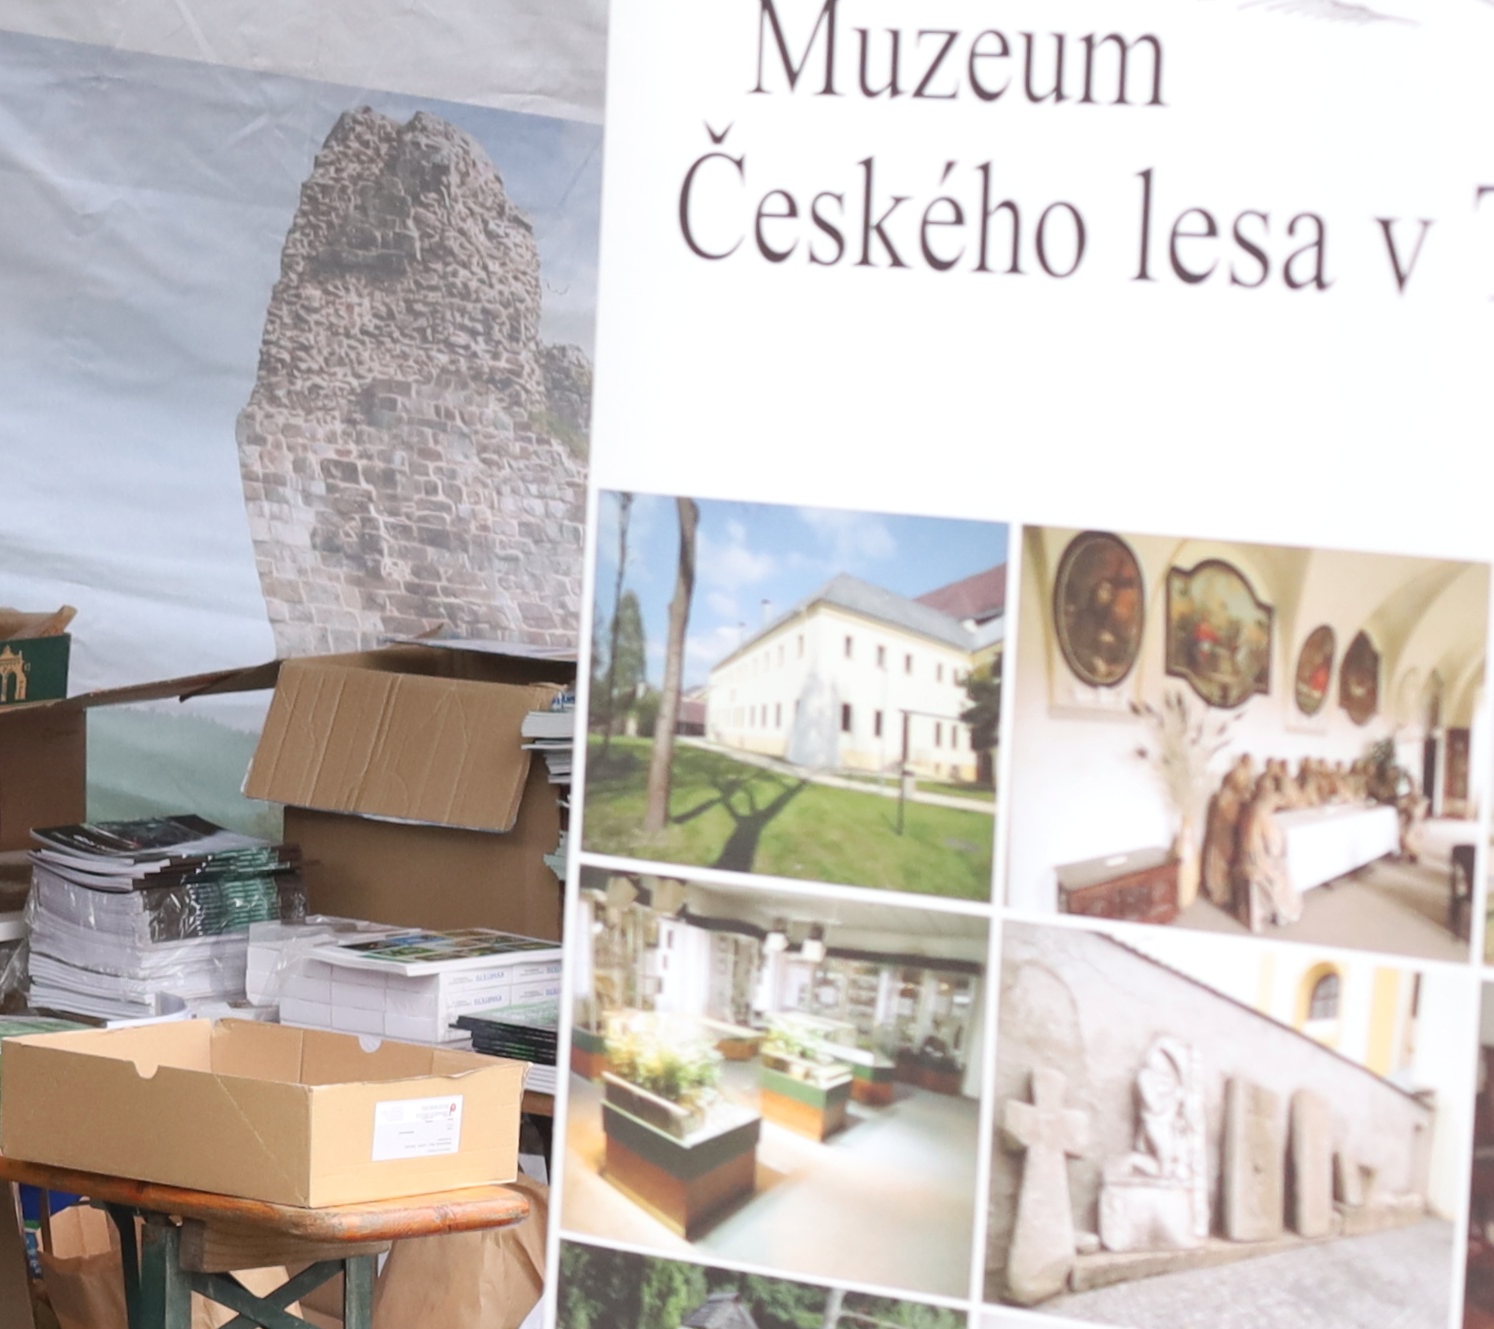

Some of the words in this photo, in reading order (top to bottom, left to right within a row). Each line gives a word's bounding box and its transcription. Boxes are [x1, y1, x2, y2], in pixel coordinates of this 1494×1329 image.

[677, 121, 1088, 279] Českého
[1130, 167, 1336, 292] lesa
[1375, 217, 1436, 296] v
